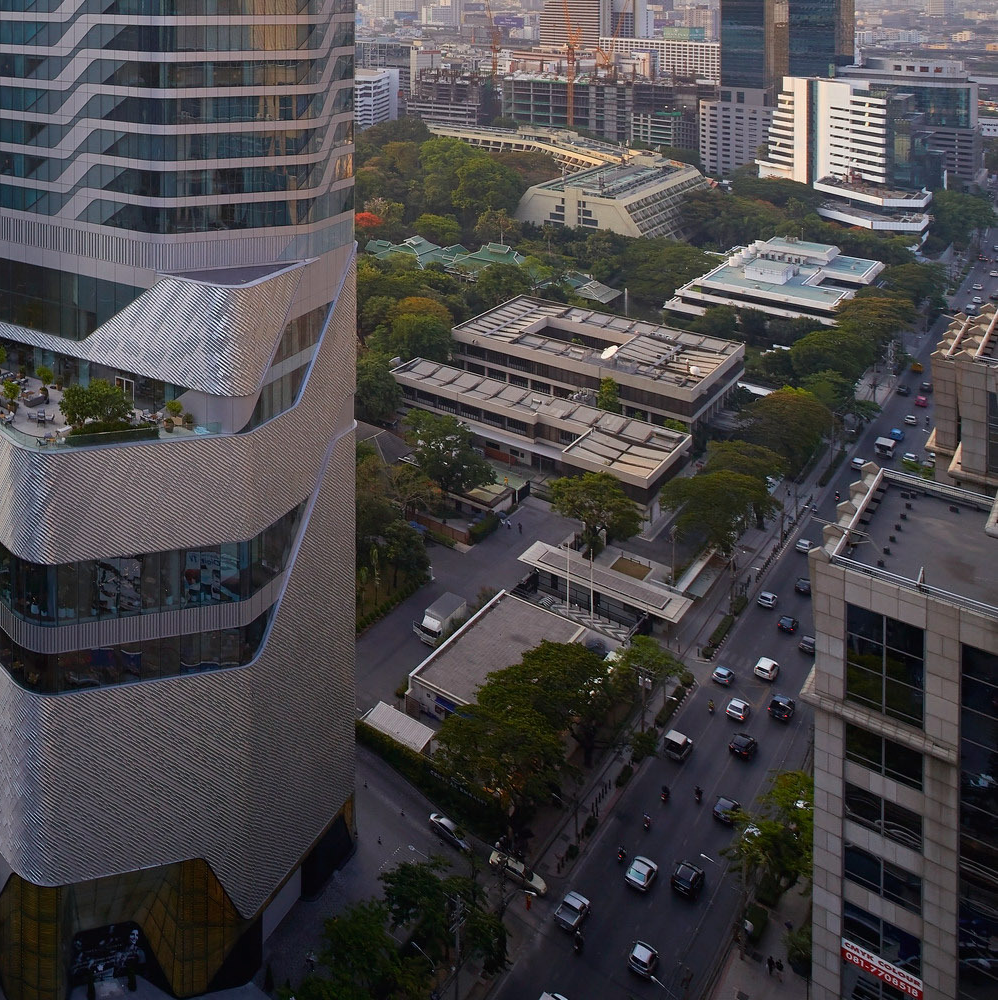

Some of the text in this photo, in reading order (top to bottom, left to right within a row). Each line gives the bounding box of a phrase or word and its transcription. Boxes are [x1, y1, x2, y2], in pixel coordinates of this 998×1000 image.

[844, 942, 921, 987] CMYK COLOUR
[845, 952, 919, 997] 081-7708518
